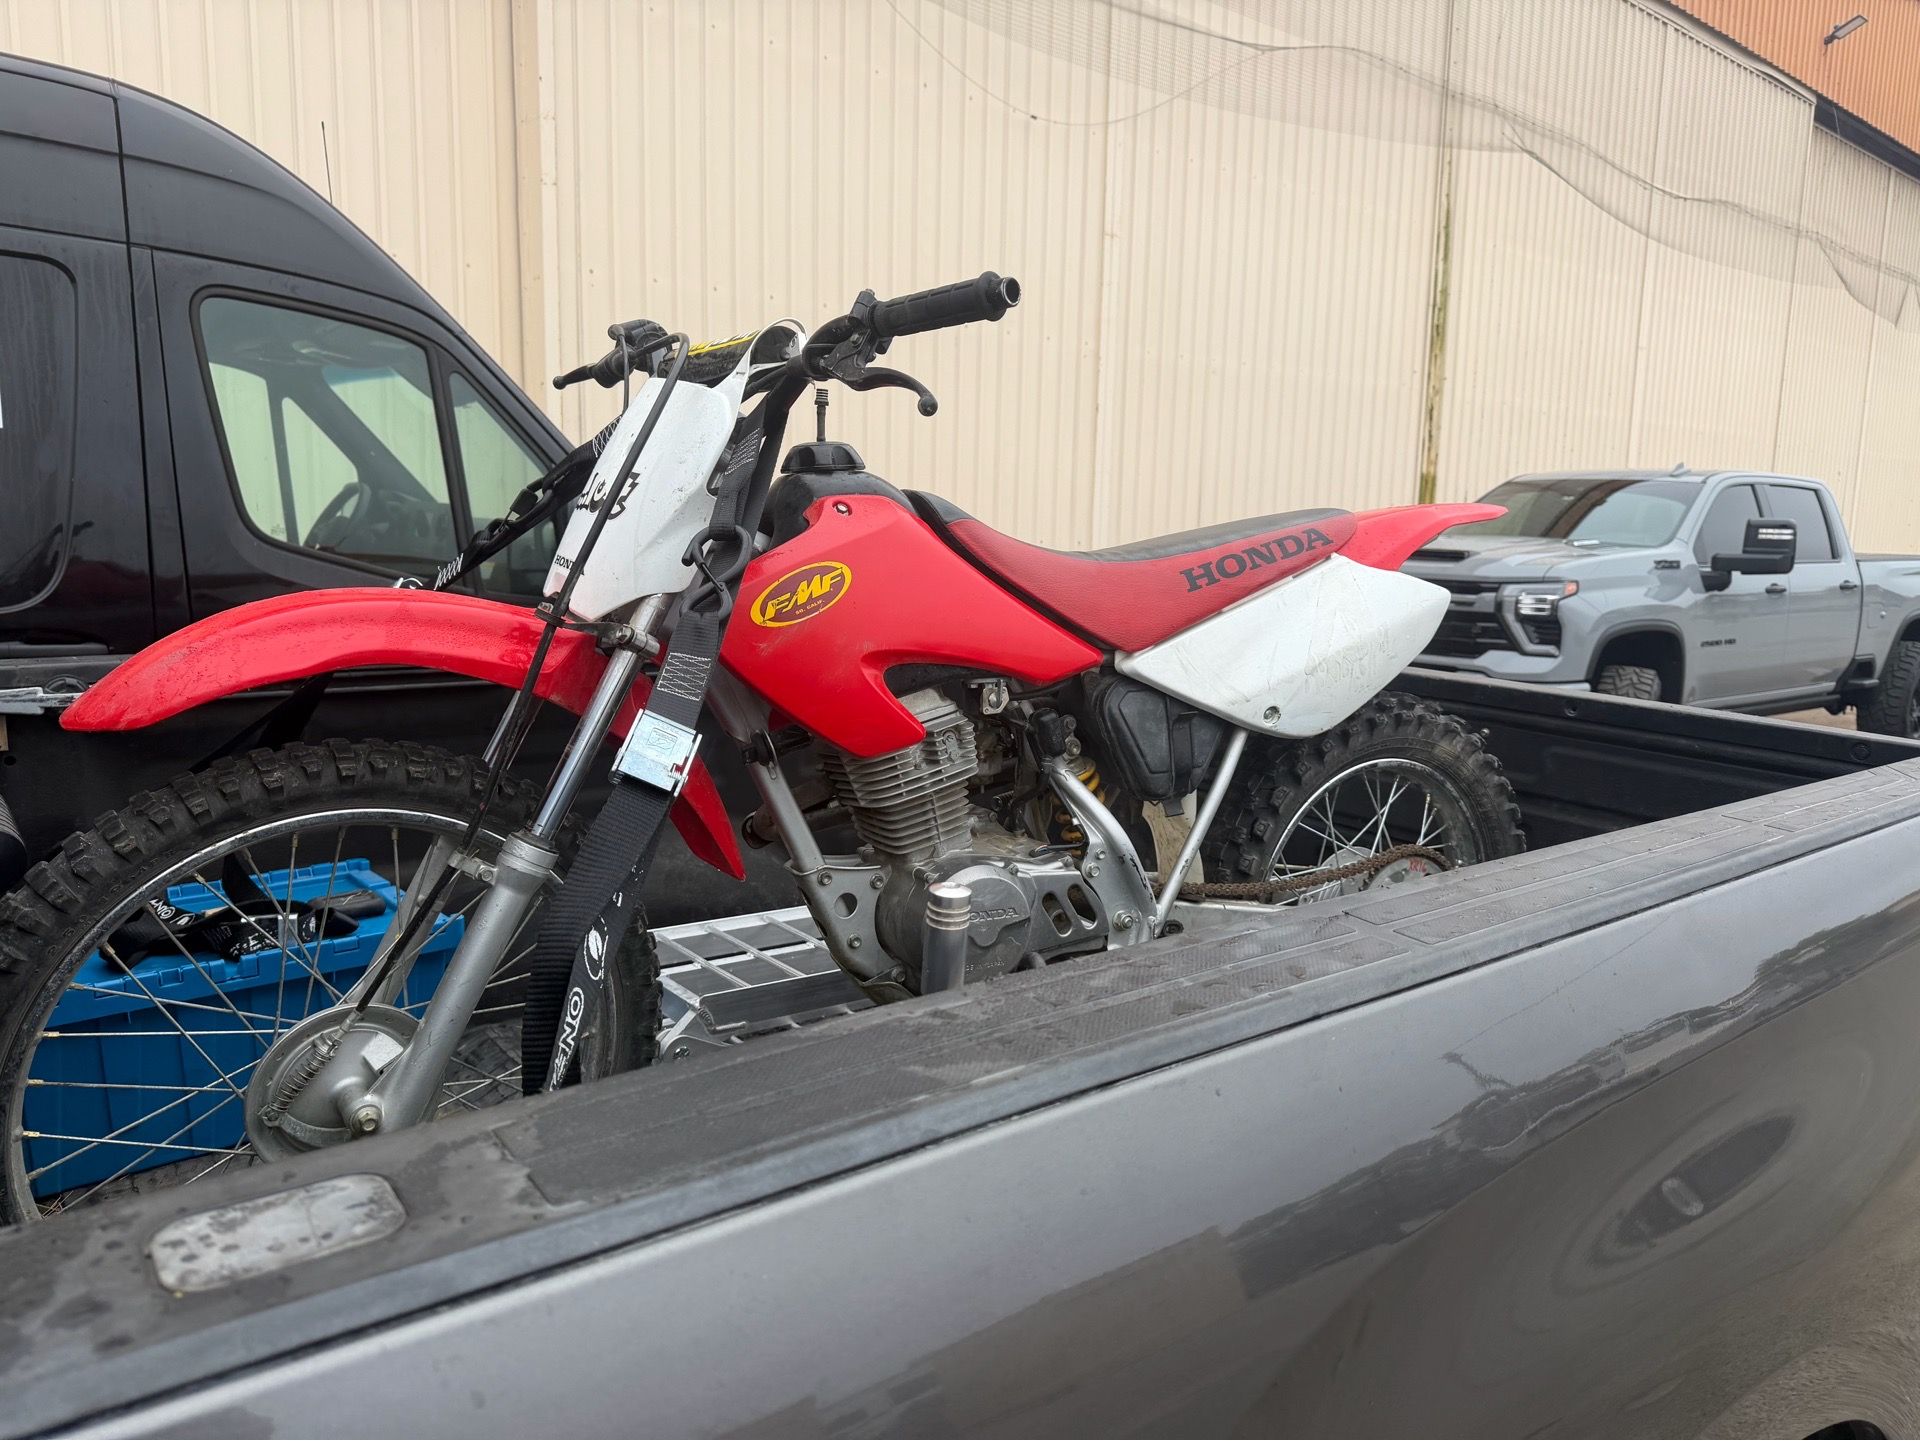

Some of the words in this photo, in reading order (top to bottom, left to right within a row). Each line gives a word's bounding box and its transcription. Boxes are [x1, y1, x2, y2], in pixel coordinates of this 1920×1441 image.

[1179, 528, 1333, 592] HONDA
[764, 566, 842, 621] FMF
[967, 906, 1020, 923] ONDA
